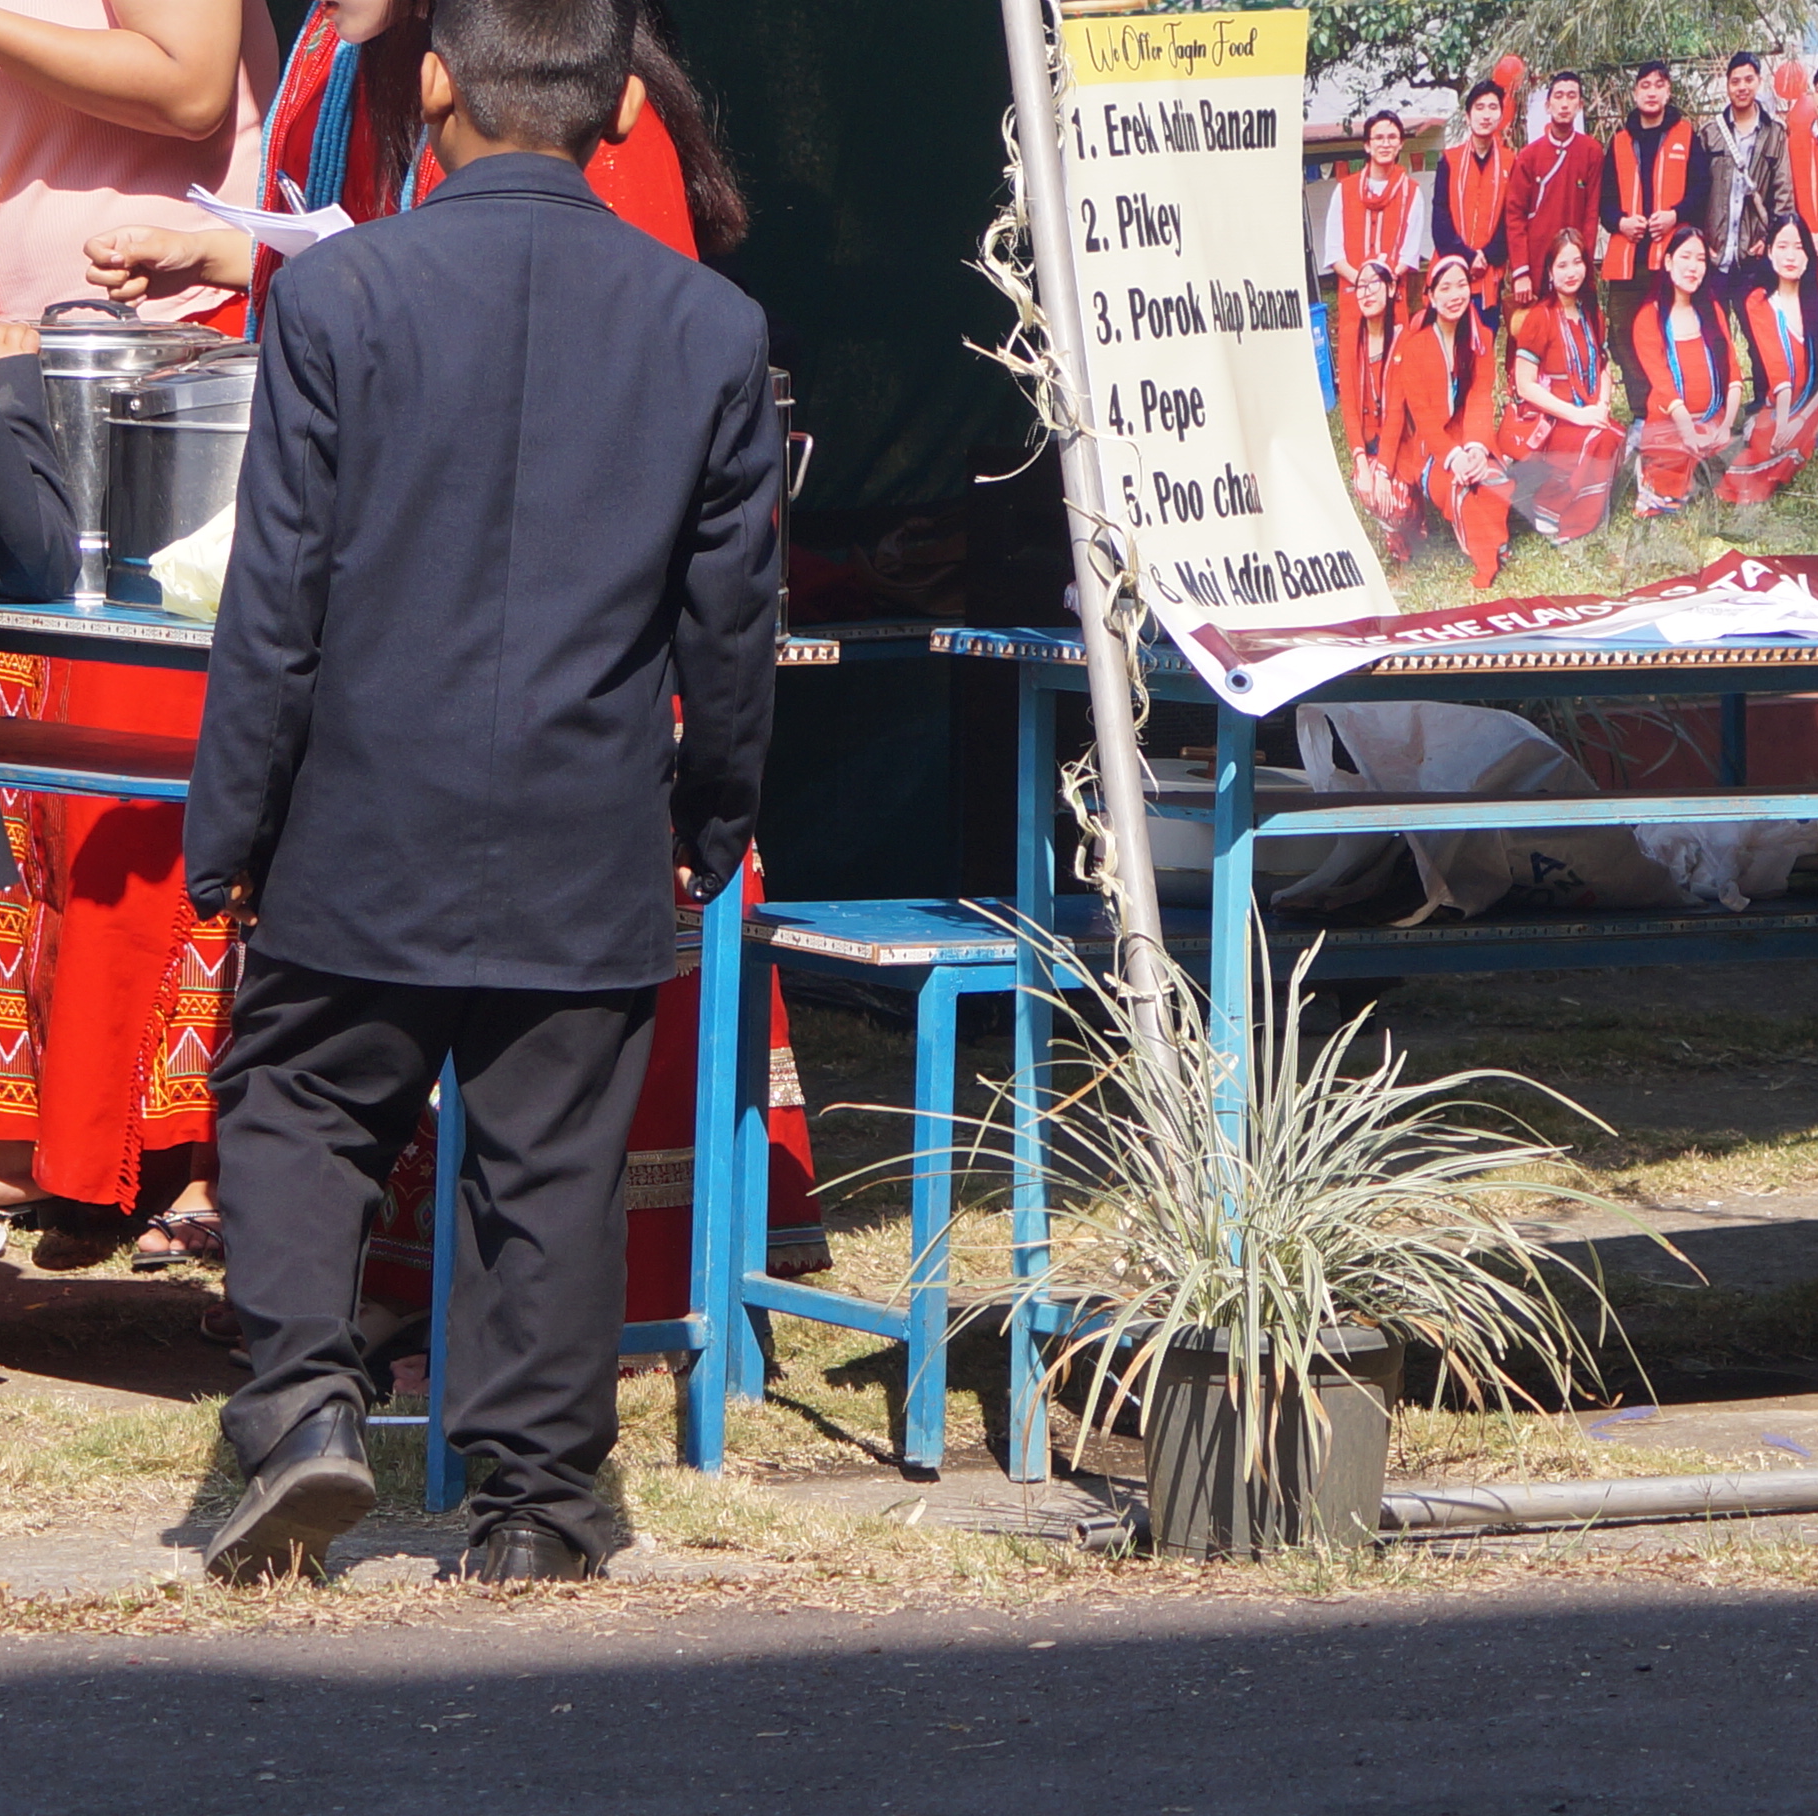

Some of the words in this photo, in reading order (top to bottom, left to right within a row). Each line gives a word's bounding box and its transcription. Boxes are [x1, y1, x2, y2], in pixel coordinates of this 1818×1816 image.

[1085, 25, 1120, 72] We
[1122, 25, 1163, 71] Offer
[1212, 19, 1258, 67] Food
[1071, 107, 1098, 160] 1.
[1104, 102, 1160, 157] Erek
[1158, 98, 1200, 153] Adin
[1199, 99, 1277, 152] Banam
[1081, 198, 1110, 253] 2.
[1116, 192, 1182, 257] Pikey
[1093, 291, 1122, 345] 3.
[1128, 281, 1208, 341] Porok
[1208, 279, 1244, 345] Alap
[1242, 279, 1304, 331] Banam
[1109, 383, 1134, 435] 4.
[1140, 379, 1206, 442] Pepe
[1122, 474, 1152, 528] 5.
[1153, 471, 1204, 524] Poo
[1223, 550, 1280, 607] Adin
[1274, 549, 1366, 600] Banam
[1394, 619, 1494, 642] THE
